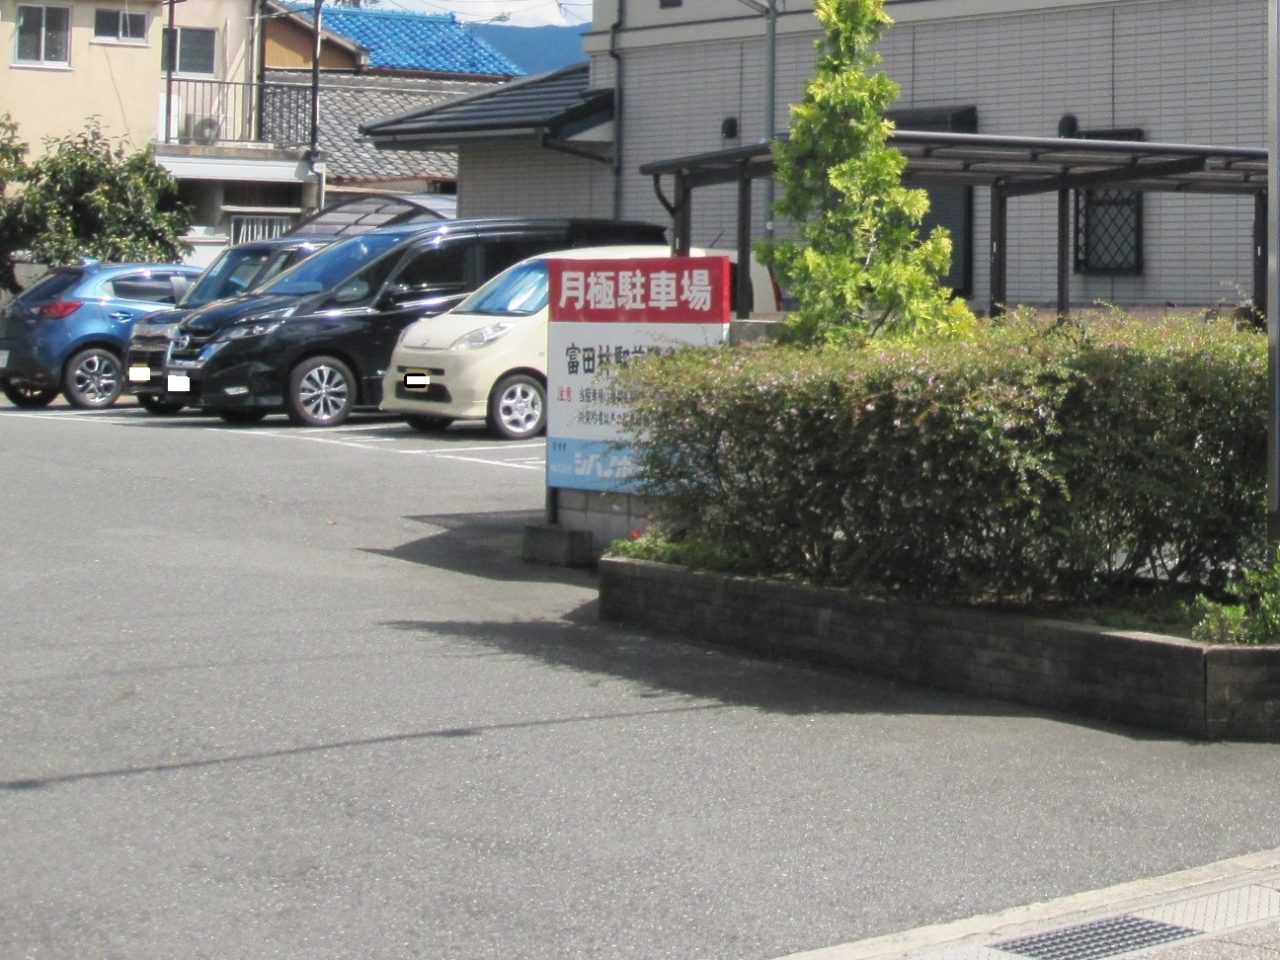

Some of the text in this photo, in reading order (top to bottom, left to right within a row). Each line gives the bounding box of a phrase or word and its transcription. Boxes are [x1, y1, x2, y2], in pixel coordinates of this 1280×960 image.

[558, 269, 712, 311] 月極駐車場
